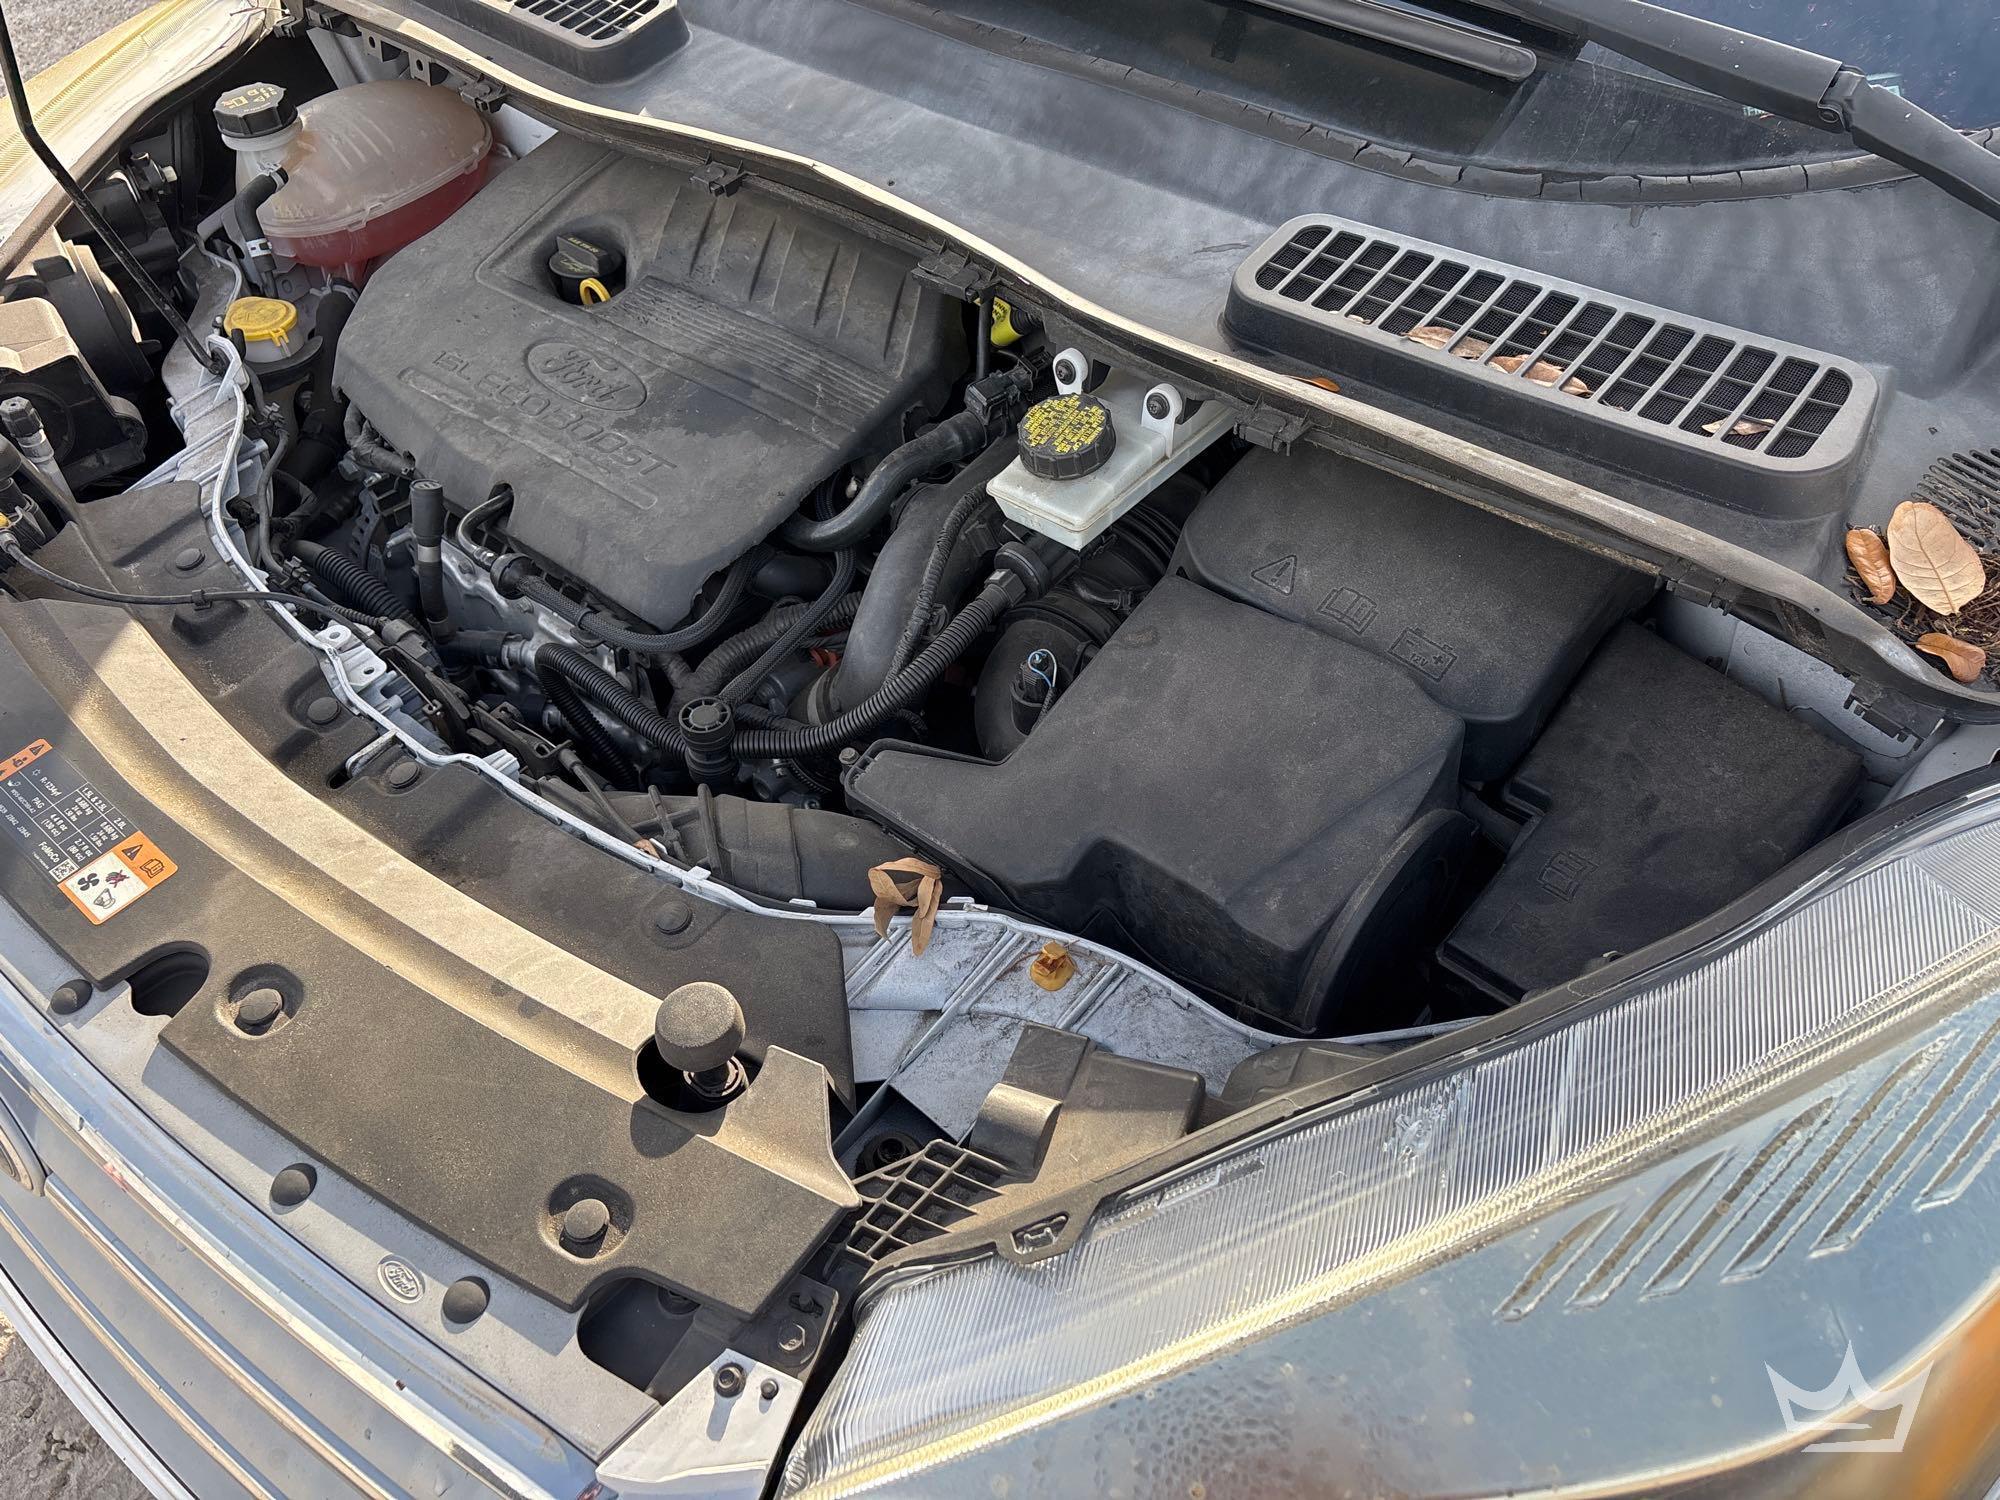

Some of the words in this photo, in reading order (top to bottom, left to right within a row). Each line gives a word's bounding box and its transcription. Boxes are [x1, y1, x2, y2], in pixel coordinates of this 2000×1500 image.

[542, 349, 630, 403] Ford
[1409, 653, 1430, 667] 12V
[40, 776, 62, 797] R-1234yf
[32, 797, 45, 809] PAG
[38, 841, 60, 863] FoMoCo
